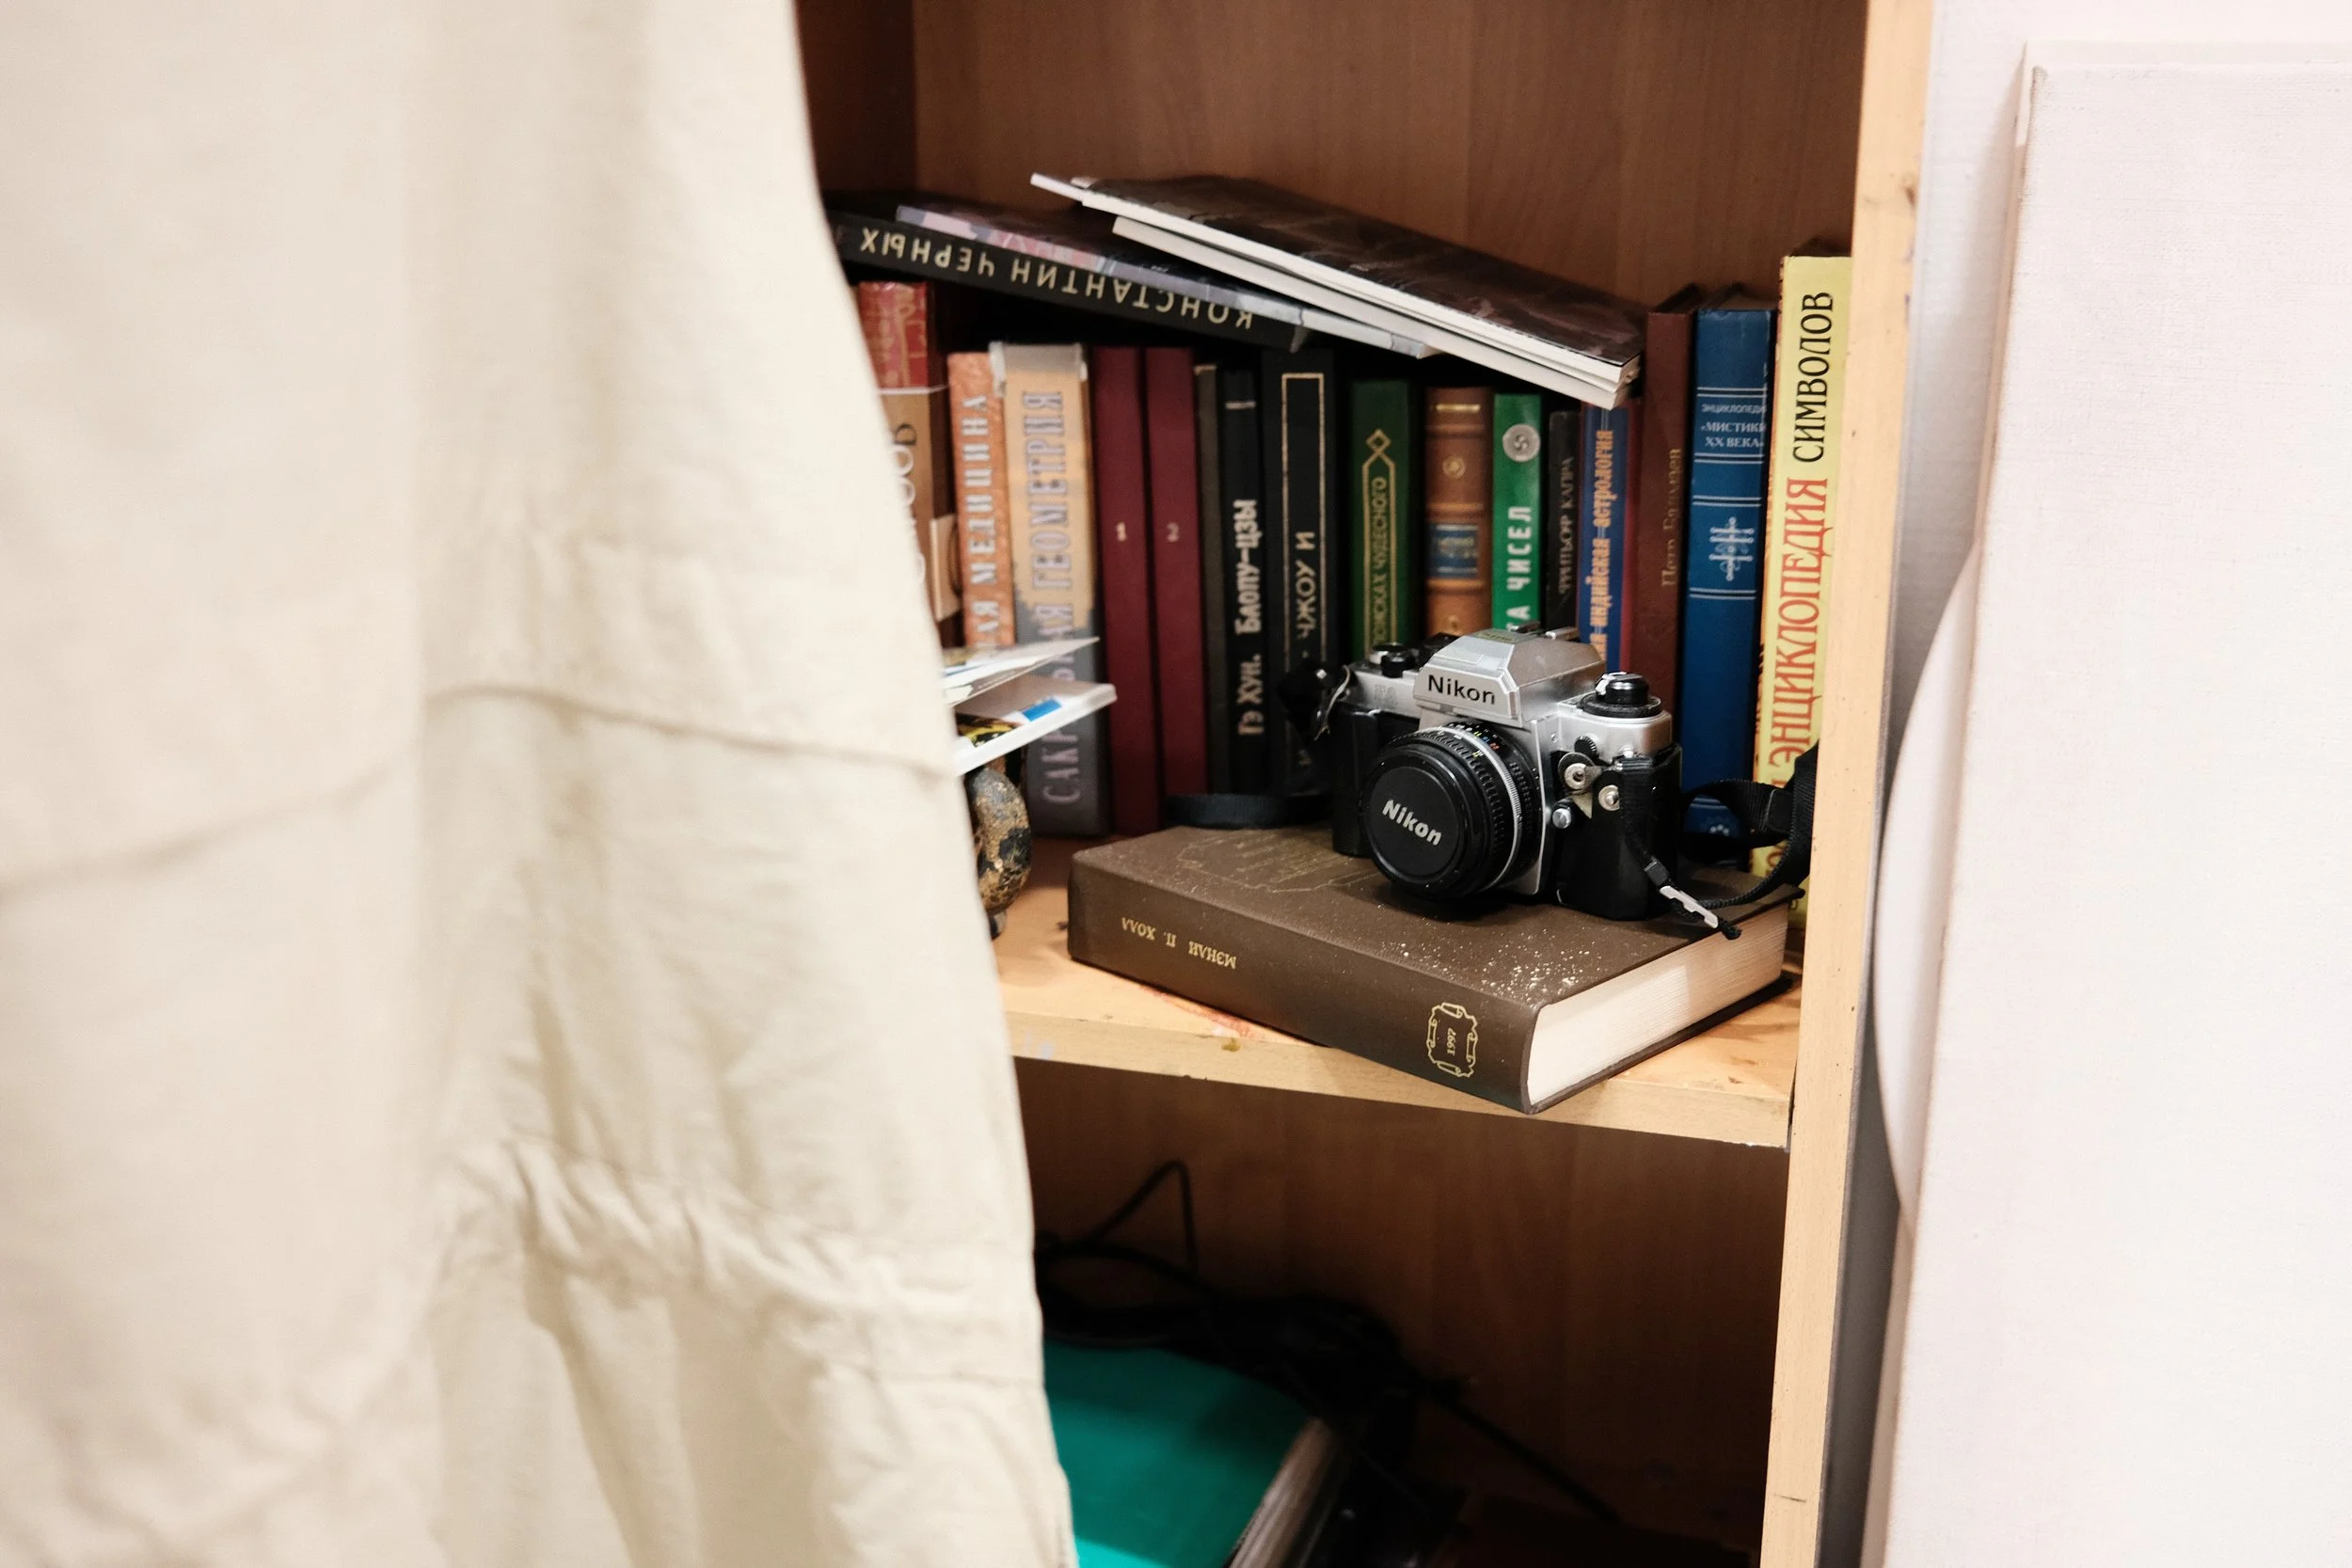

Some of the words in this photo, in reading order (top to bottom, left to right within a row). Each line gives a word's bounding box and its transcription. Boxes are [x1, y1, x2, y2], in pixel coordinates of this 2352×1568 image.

[860, 227, 995, 277] ЧЕРНЫХ
[1011, 257, 1253, 329] КОНСТАНТИН
[1791, 293, 1834, 463] СИМВОЛОВ
[1701, 404, 1767, 415] ЭНЦИКЛОПЕДИ
[961, 393, 997, 585] МЕДИЦИНА
[1021, 390, 1073, 591] ГЕОМЕТРИЯ
[1593, 429, 1618, 529] астрология
[1295, 531, 1316, 551] И
[1506, 505, 1533, 592] ЧИСЕЛ
[1295, 559, 1317, 640] ЧЖОУ
[1769, 479, 1833, 767] ЭНЦИКЛОПЕДИЯ
[1427, 674, 1496, 705] Nikon
[1381, 799, 1442, 847] Nikon
[1120, 916, 1156, 941] ХОЛЛ
[1163, 931, 1177, 948] П.
[1187, 941, 1237, 970] МЭНЛИ
[1446, 1027, 1456, 1056] 1997
